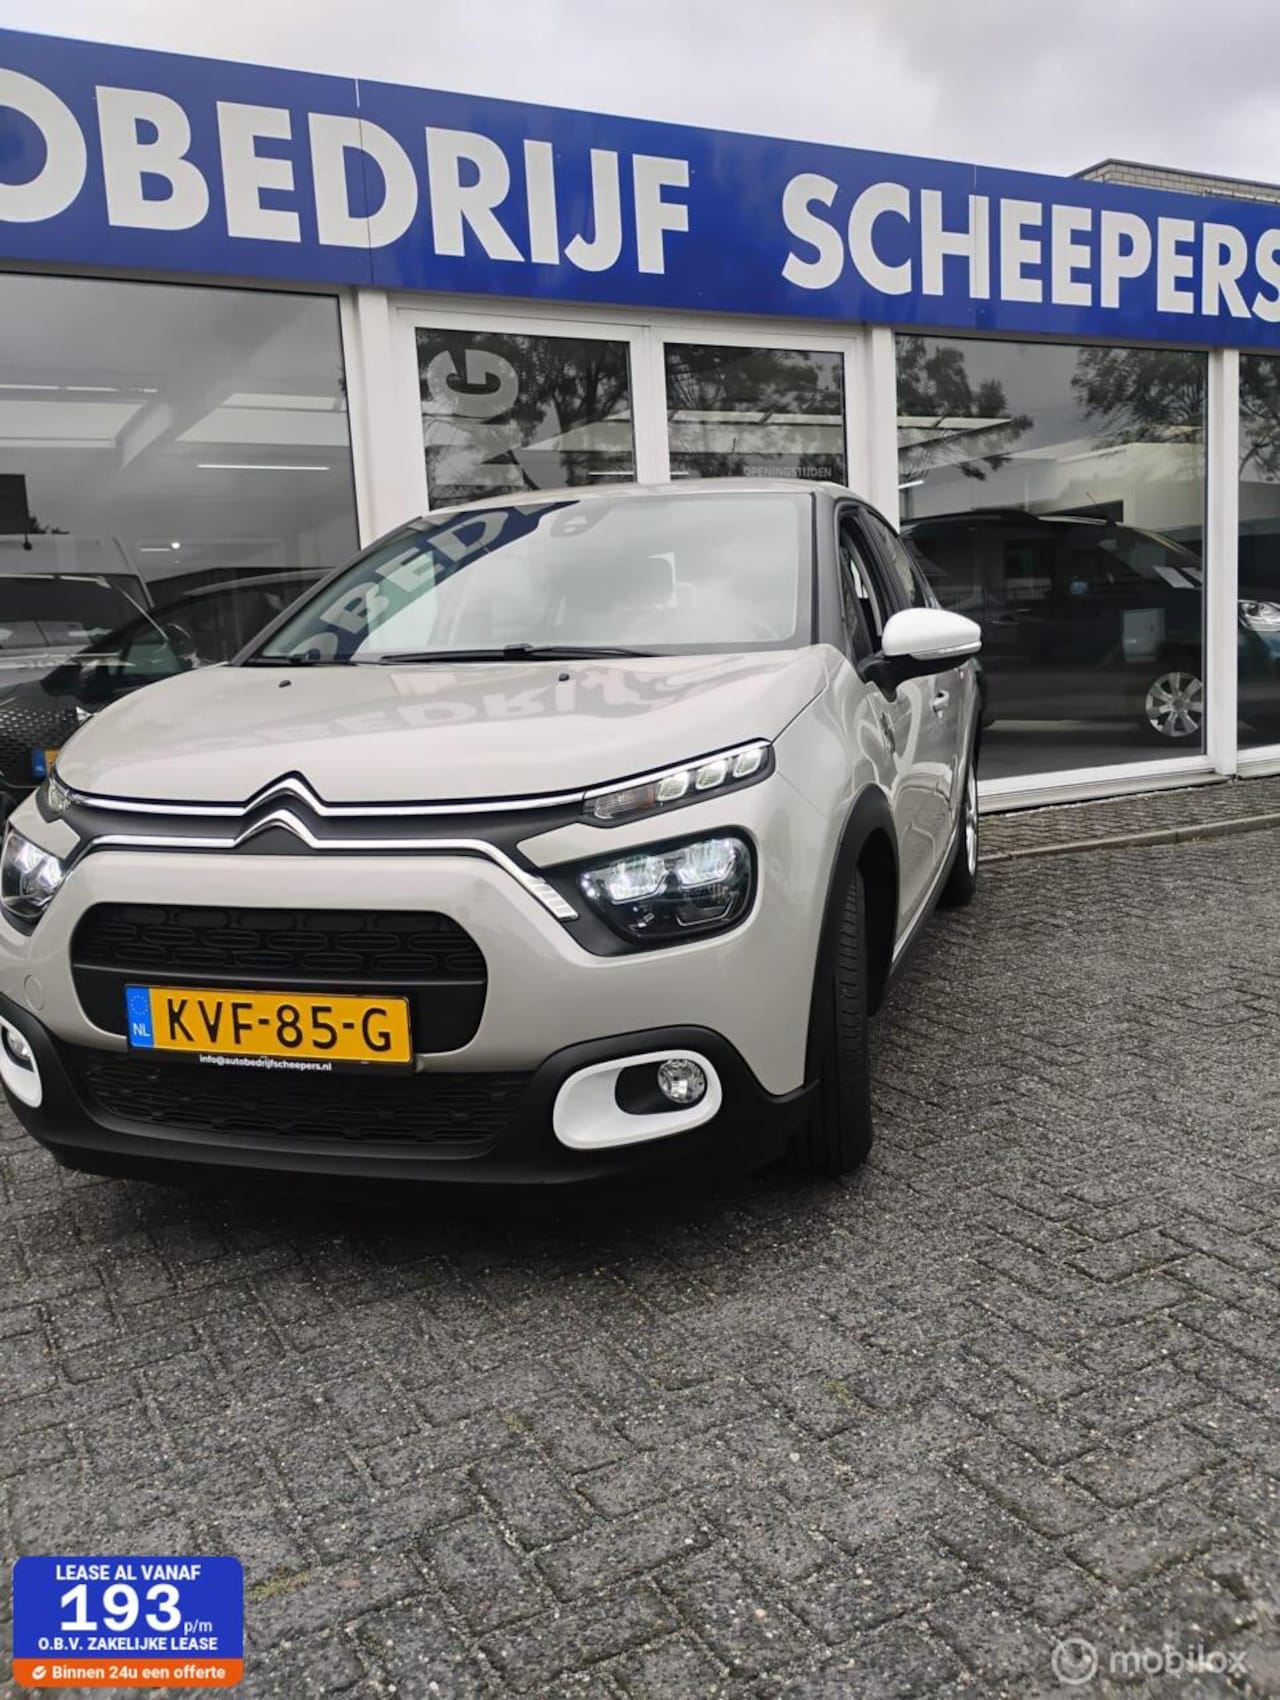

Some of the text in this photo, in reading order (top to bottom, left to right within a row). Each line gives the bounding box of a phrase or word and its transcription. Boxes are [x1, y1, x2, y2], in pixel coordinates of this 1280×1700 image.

[782, 173, 1280, 323] SCHEEPERS
[132, 998, 392, 1052] NL KVF-85-G
[199, 1054, 332, 1072] info@autobedrijfscheepers.nl
